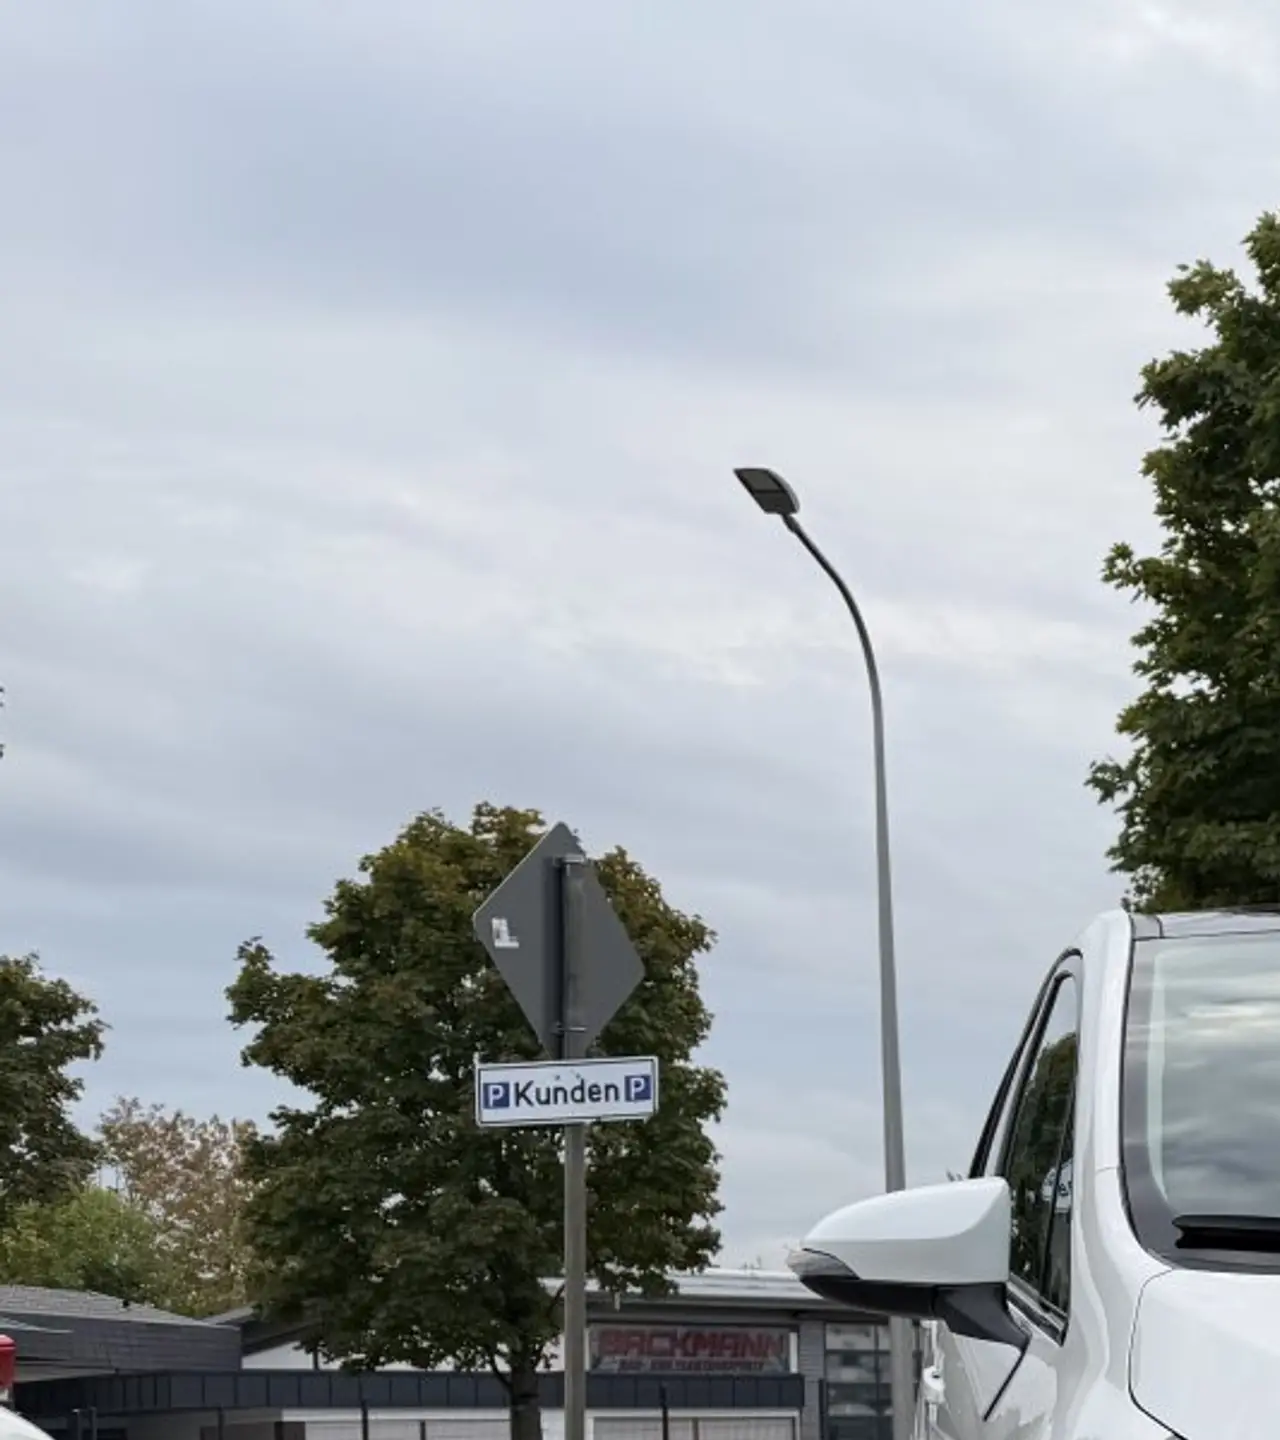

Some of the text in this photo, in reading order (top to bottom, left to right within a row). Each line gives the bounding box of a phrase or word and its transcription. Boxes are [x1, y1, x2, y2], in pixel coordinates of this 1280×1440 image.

[488, 1077, 645, 1108] P Kunden P
